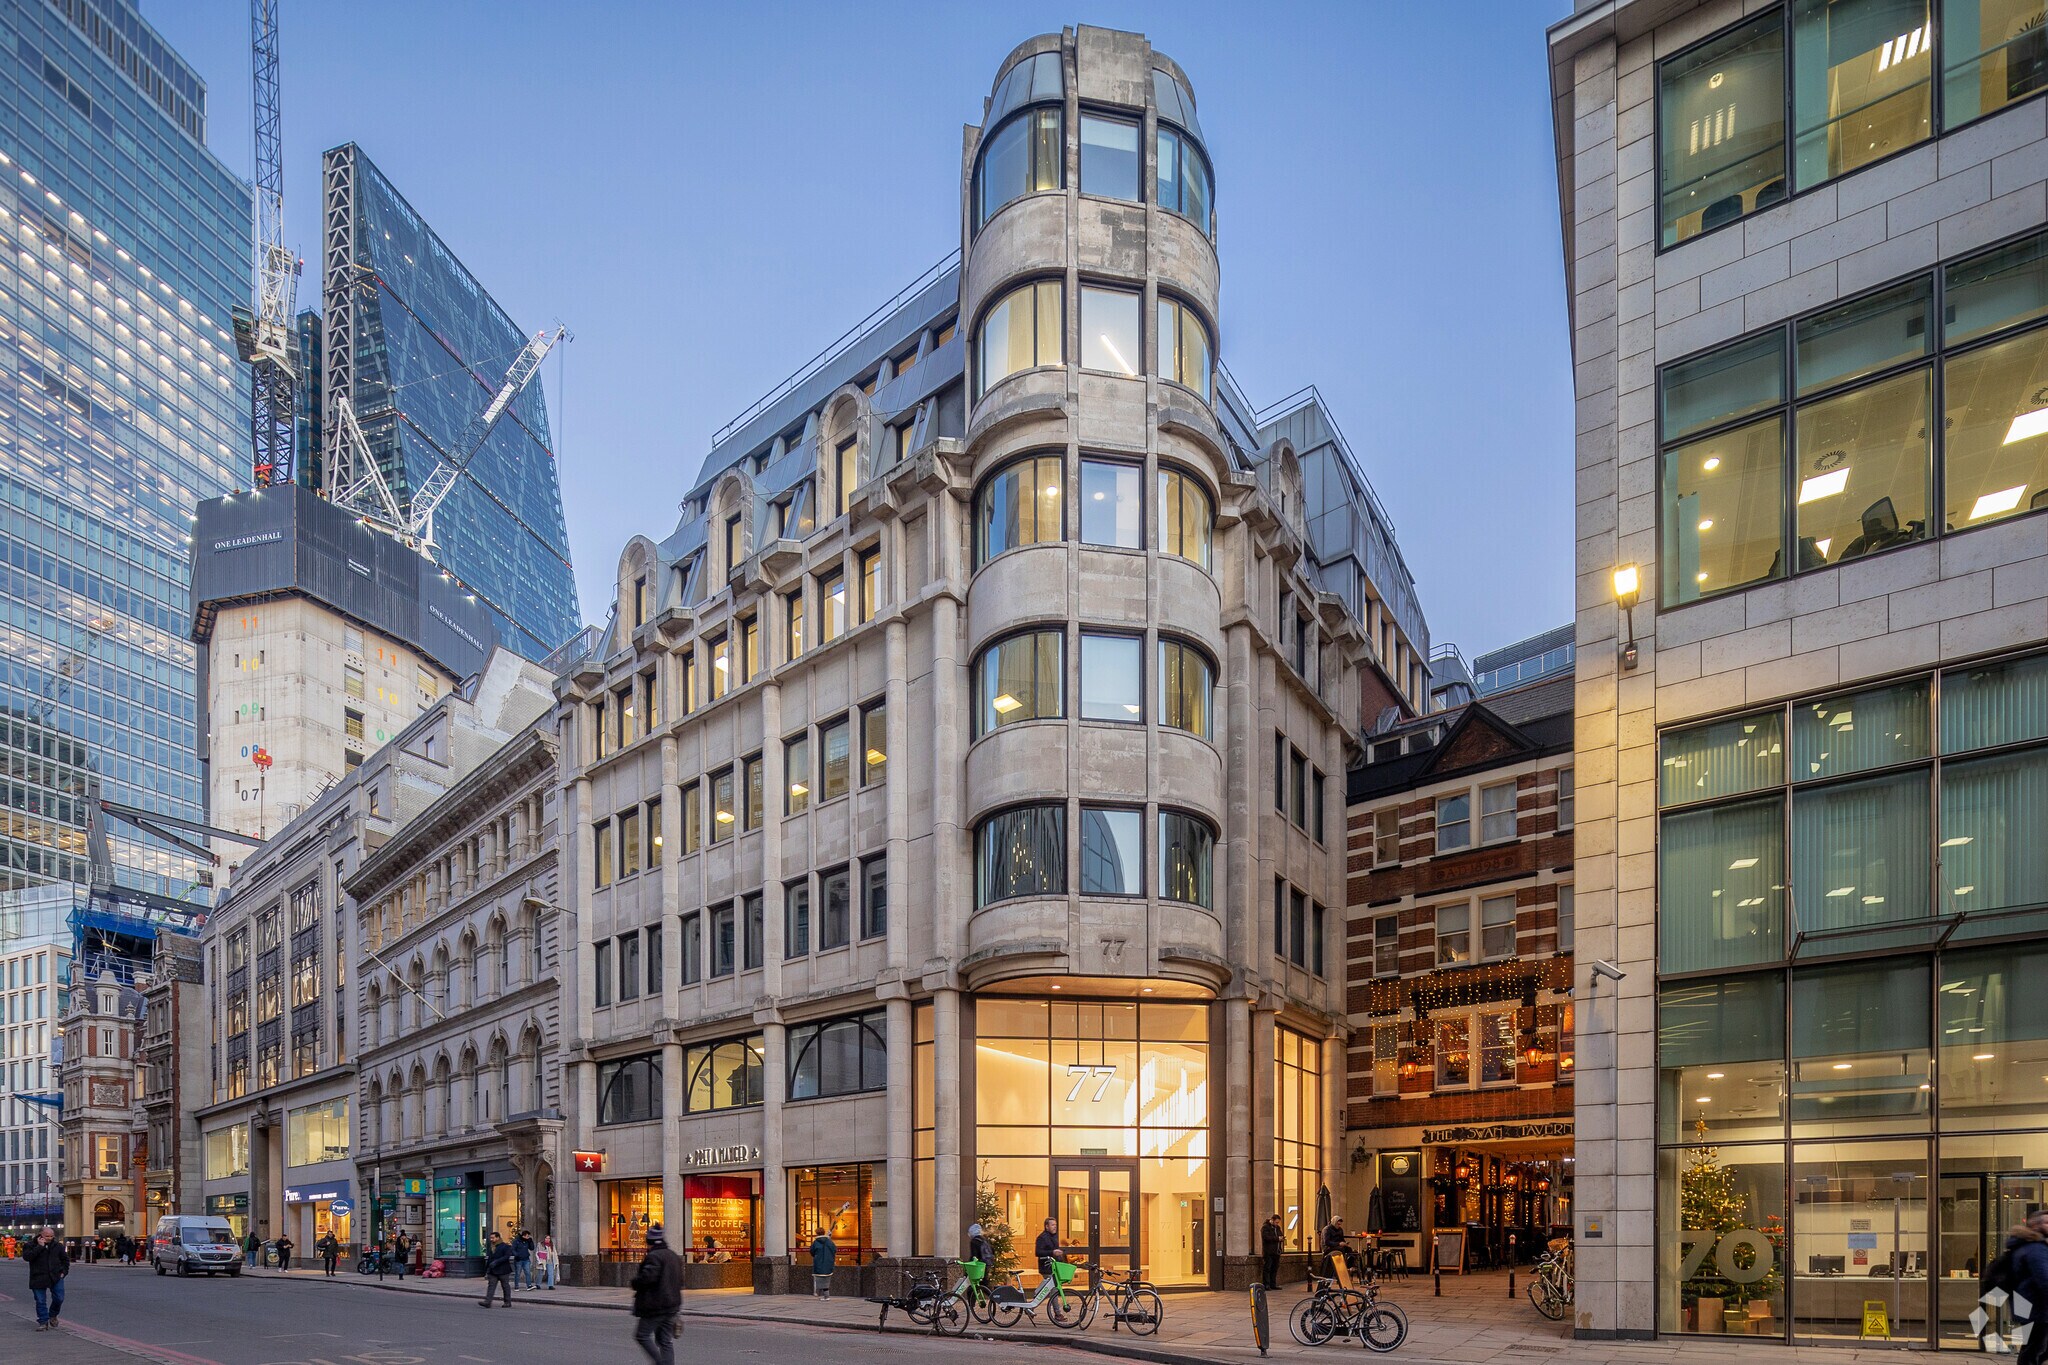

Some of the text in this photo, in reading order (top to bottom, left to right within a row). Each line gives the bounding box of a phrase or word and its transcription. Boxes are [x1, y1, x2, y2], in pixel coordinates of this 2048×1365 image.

[214, 531, 282, 549] ONE LEADENHALL
[241, 616, 258, 630] 11
[430, 605, 484, 650] ONE LEADENHALL
[241, 658, 259, 672] 10
[377, 647, 397, 666] 11
[377, 687, 398, 705] 10
[240, 703, 259, 716] 09
[241, 788, 259, 801] 07
[1100, 939, 1127, 956] 77
[1066, 1065, 1117, 1102] 77
[1428, 1123, 1574, 1141] THE SWAN TAVERN
[695, 1148, 712, 1166] PRET
[712, 1149, 719, 1164] A
[1667, 1229, 1774, 1284] 70
